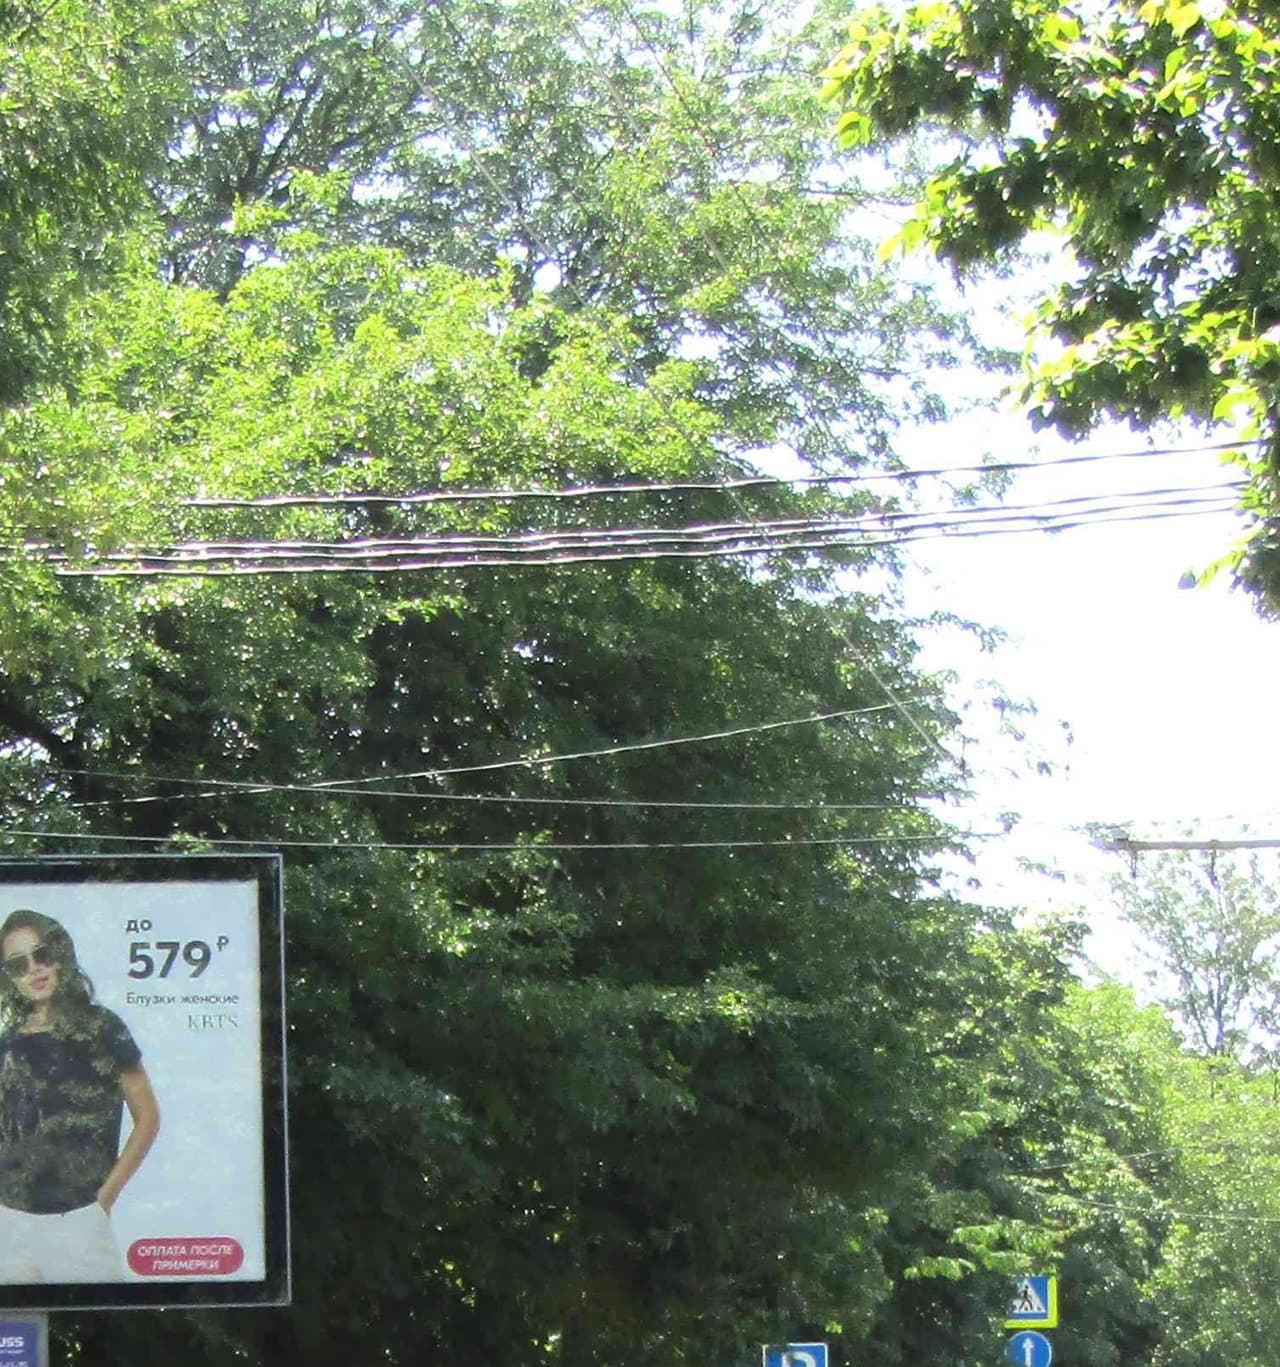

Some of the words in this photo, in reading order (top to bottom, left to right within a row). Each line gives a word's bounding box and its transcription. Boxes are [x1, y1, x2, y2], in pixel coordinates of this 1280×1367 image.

[126, 919, 153, 934] до
[126, 992, 176, 1007] Блузки
[181, 993, 241, 1006] женские
[138, 1244, 187, 1258] ОПЛАТА
[191, 1243, 234, 1257] ПОСЛЕ
[152, 1259, 219, 1271] ПРИМЕРКИ
